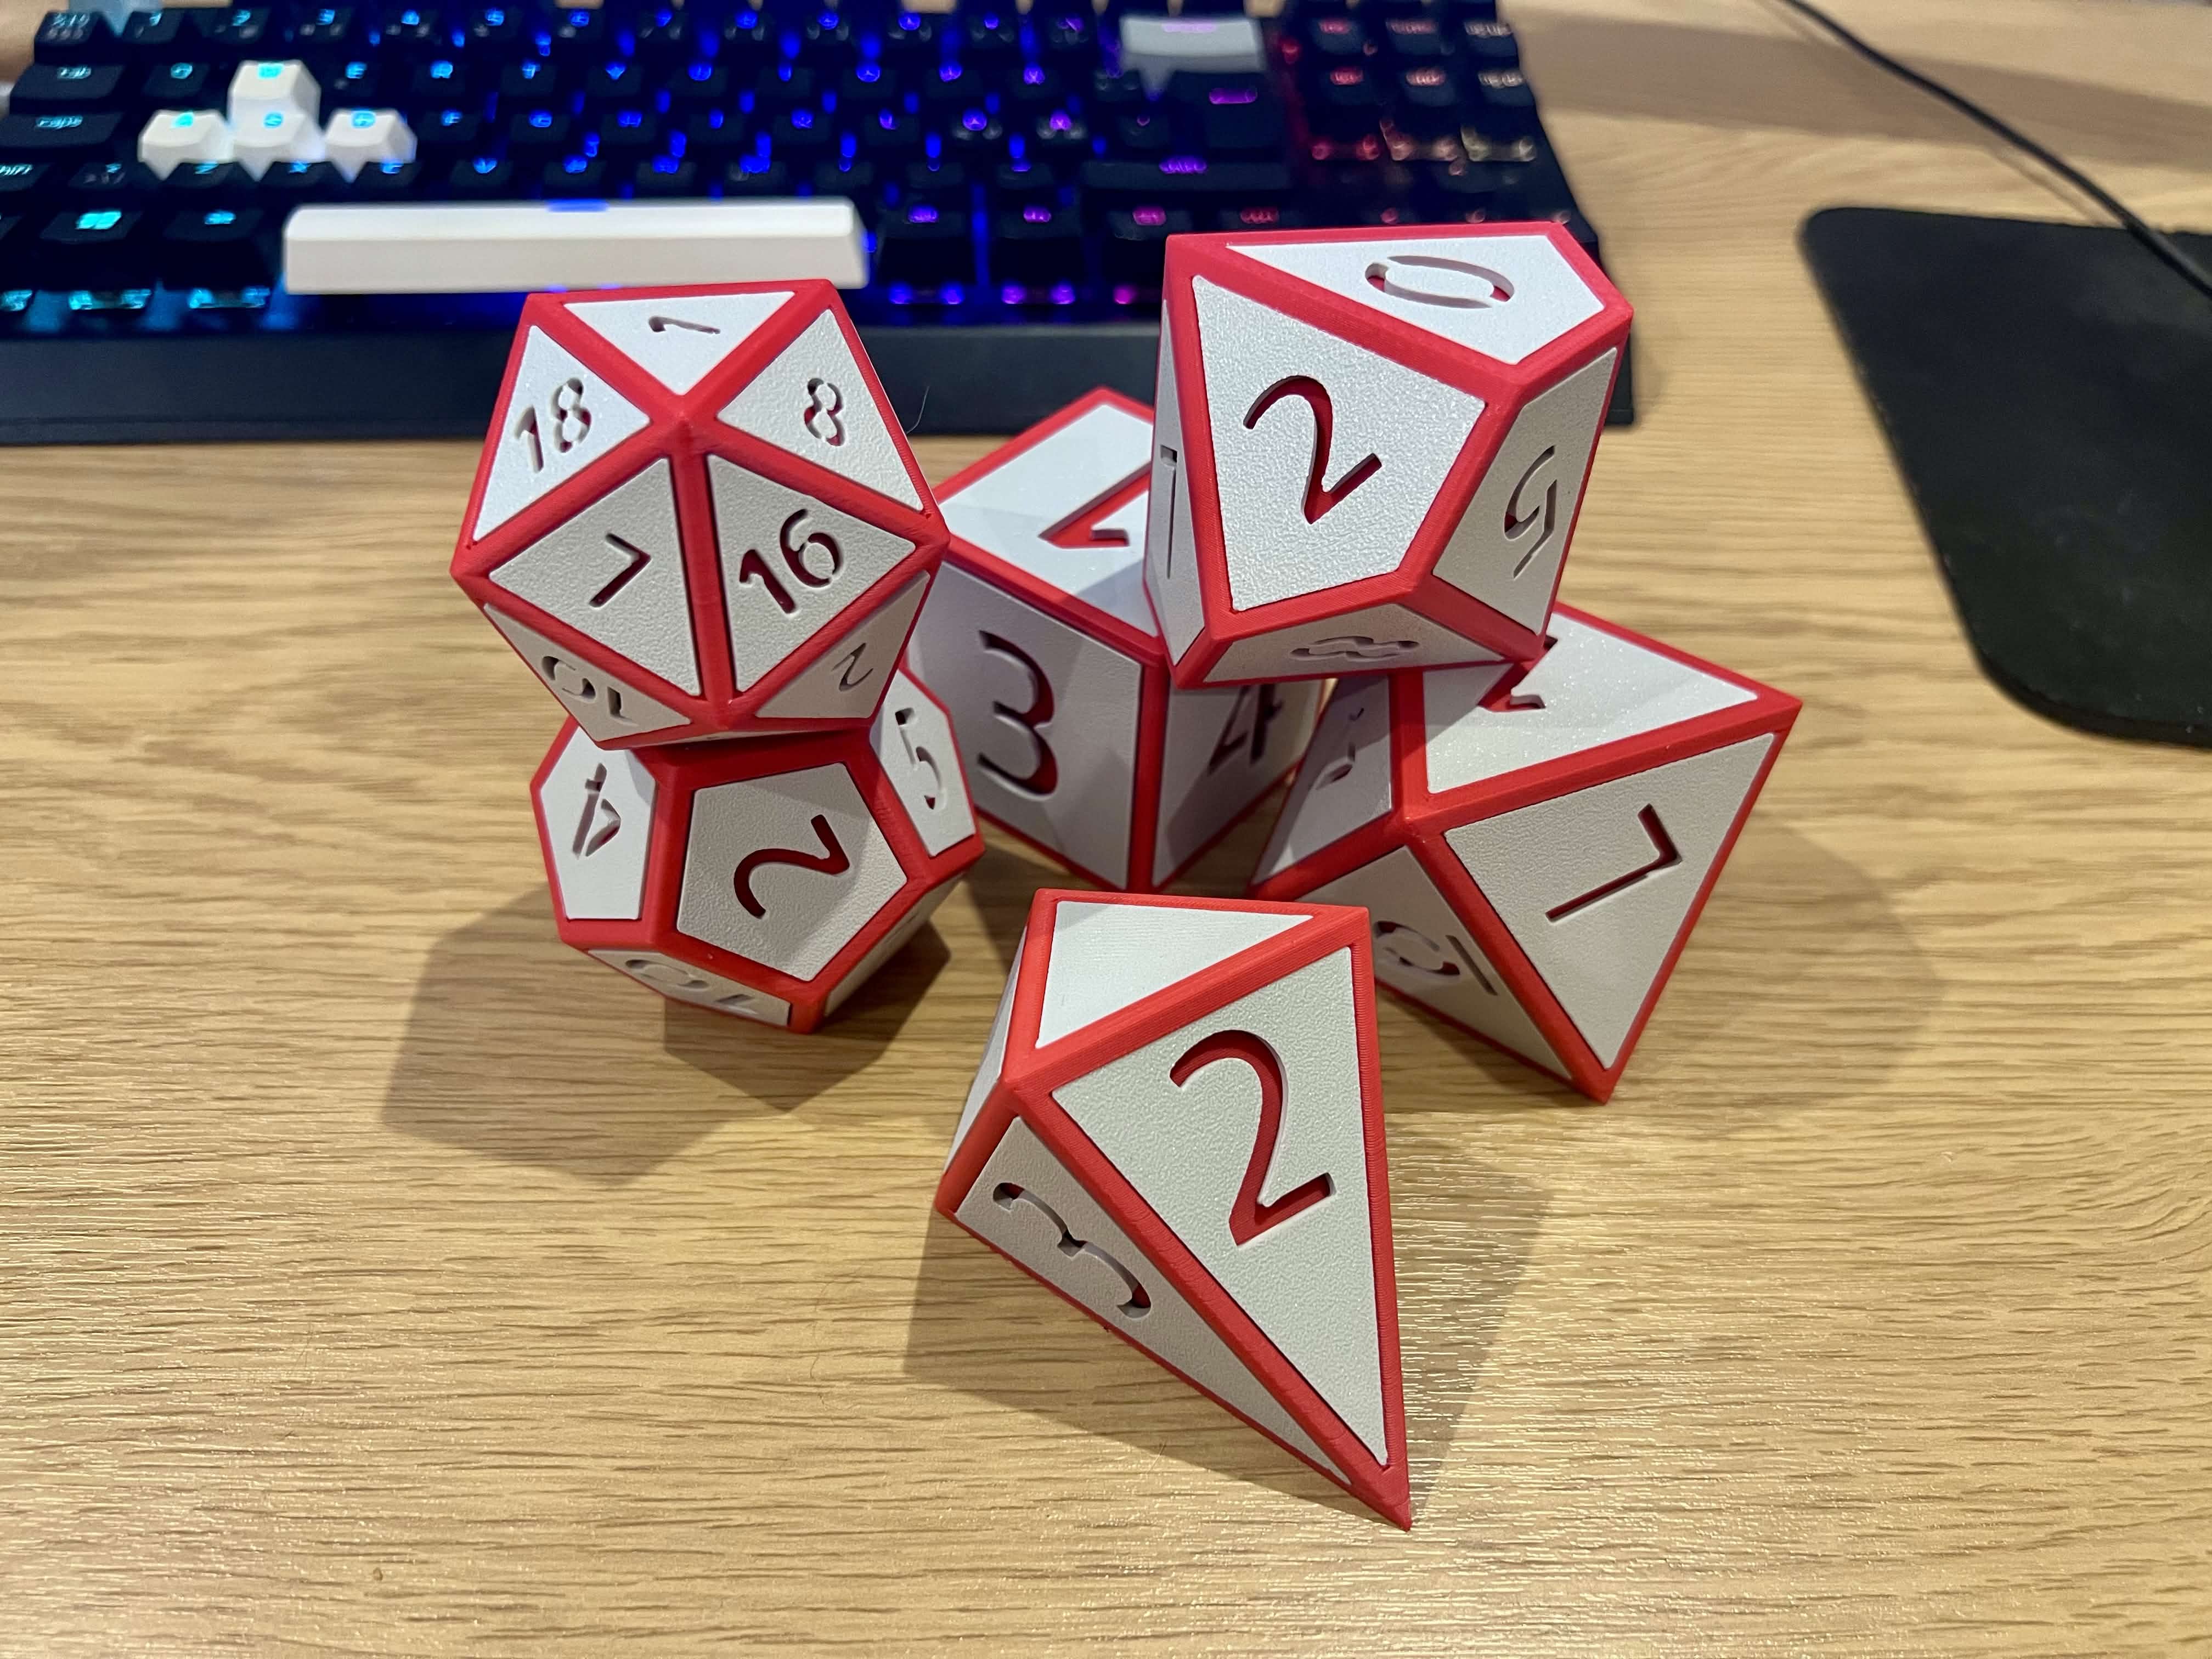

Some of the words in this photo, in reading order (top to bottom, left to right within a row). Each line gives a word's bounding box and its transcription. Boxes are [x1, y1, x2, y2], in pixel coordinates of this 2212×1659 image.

[515, 377, 591, 473] 18
[804, 377, 846, 446] 8
[1243, 375, 1383, 525] 2
[740, 509, 843, 614] 16
[831, 642, 874, 692] 2
[978, 630, 1058, 801] 3
[895, 707, 947, 811] 5
[1209, 684, 1284, 774] 4
[572, 763, 622, 859] 4
[733, 814, 850, 919] 2
[1169, 1029, 1337, 1247] 2
[992, 1182, 1152, 1319] 3
